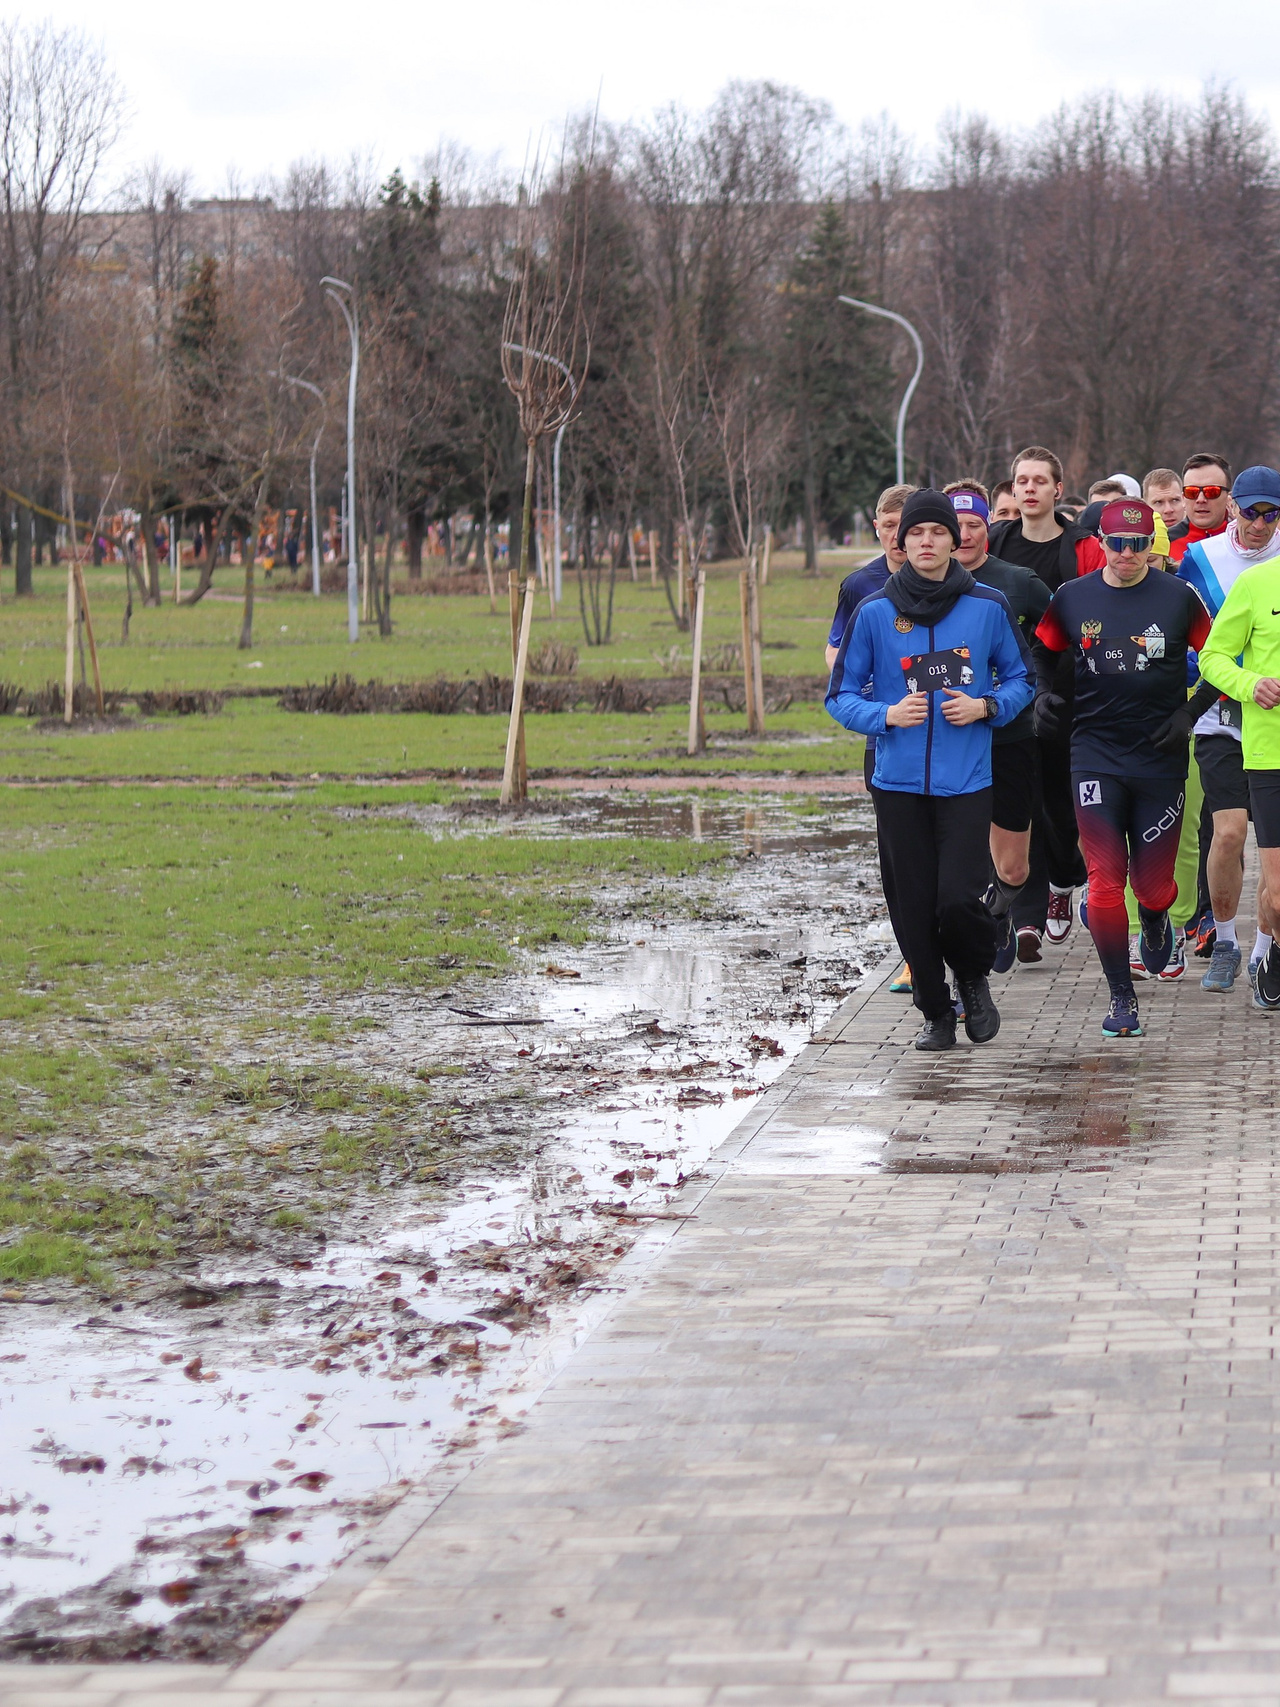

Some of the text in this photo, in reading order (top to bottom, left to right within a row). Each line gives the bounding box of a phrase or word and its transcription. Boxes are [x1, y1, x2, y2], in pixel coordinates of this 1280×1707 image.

[1105, 649, 1123, 660] 065
[928, 664, 948, 676] 018
[1142, 792, 1184, 843] odlo
